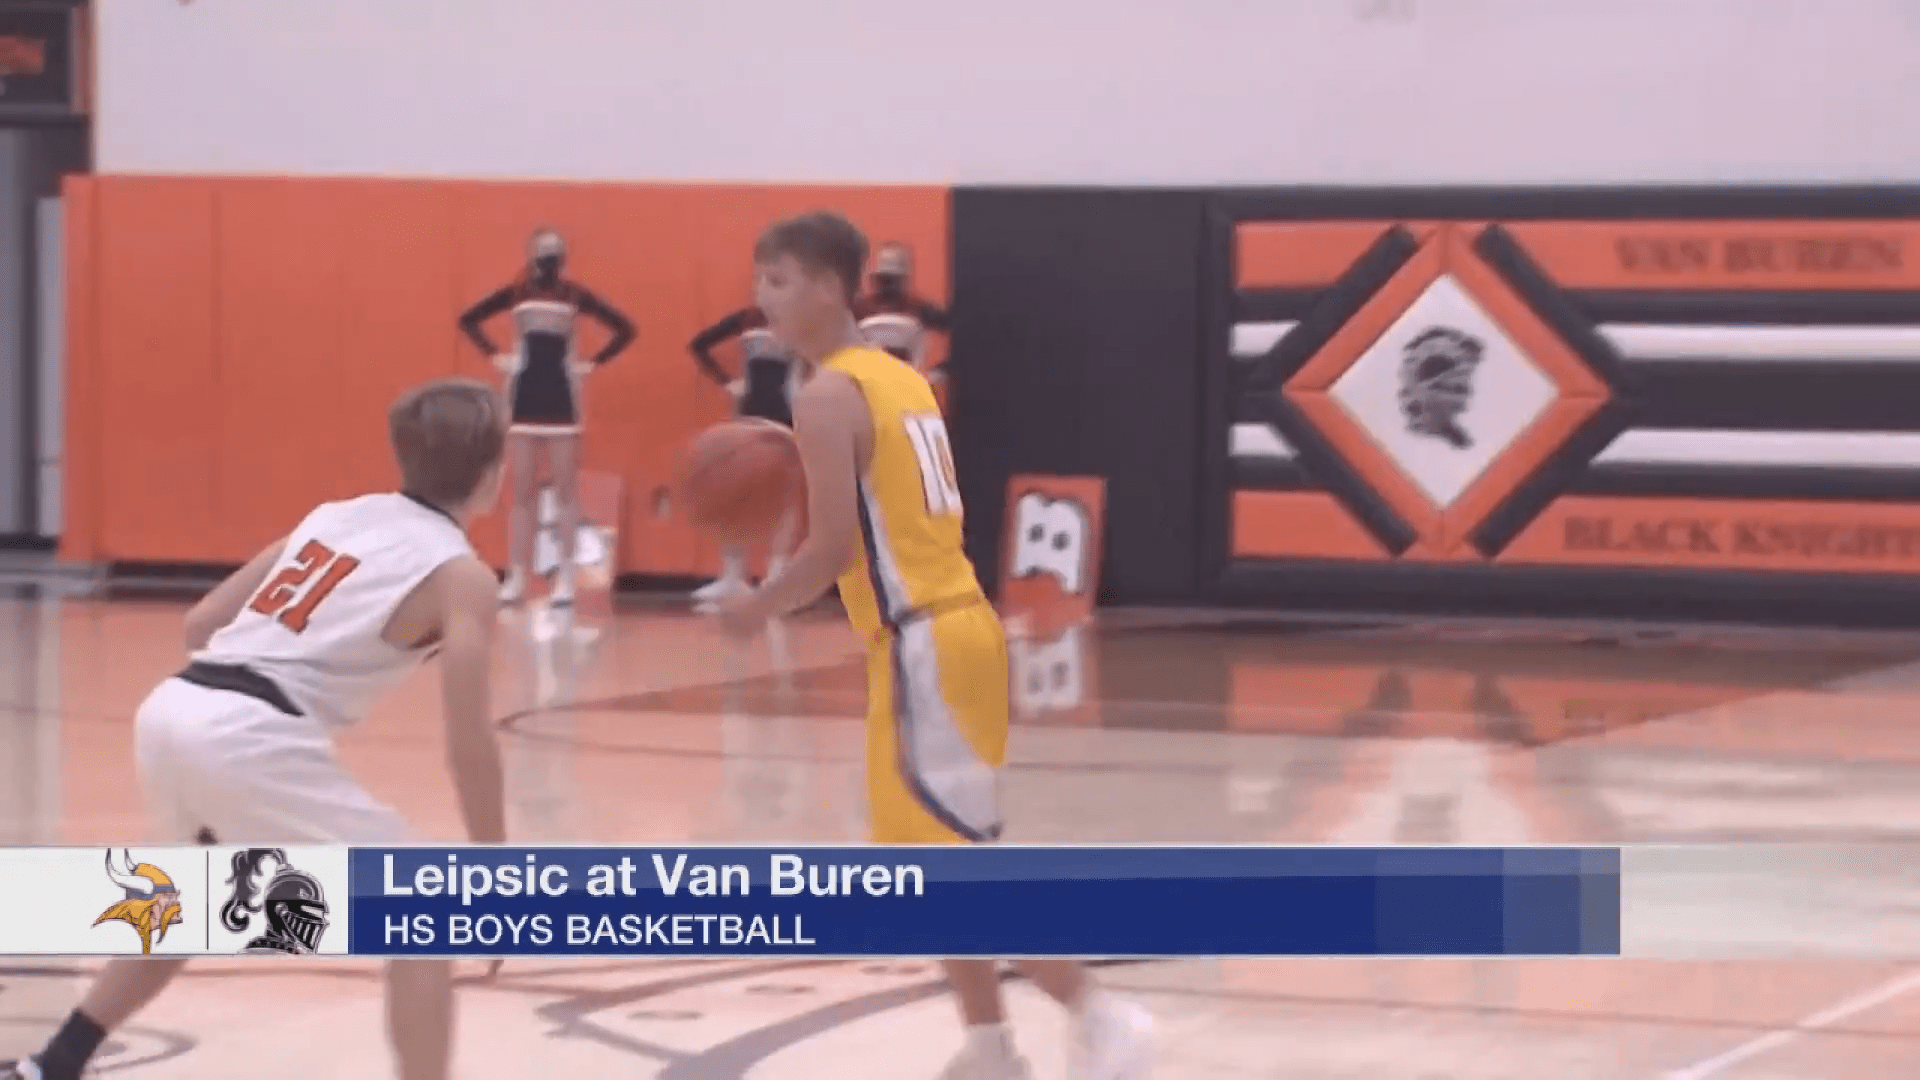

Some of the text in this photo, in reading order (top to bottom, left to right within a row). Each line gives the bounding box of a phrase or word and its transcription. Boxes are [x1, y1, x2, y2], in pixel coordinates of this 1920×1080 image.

[1613, 235, 1711, 273] VAN
[1564, 516, 1723, 554] BLACK
[248, 539, 361, 635] 21
